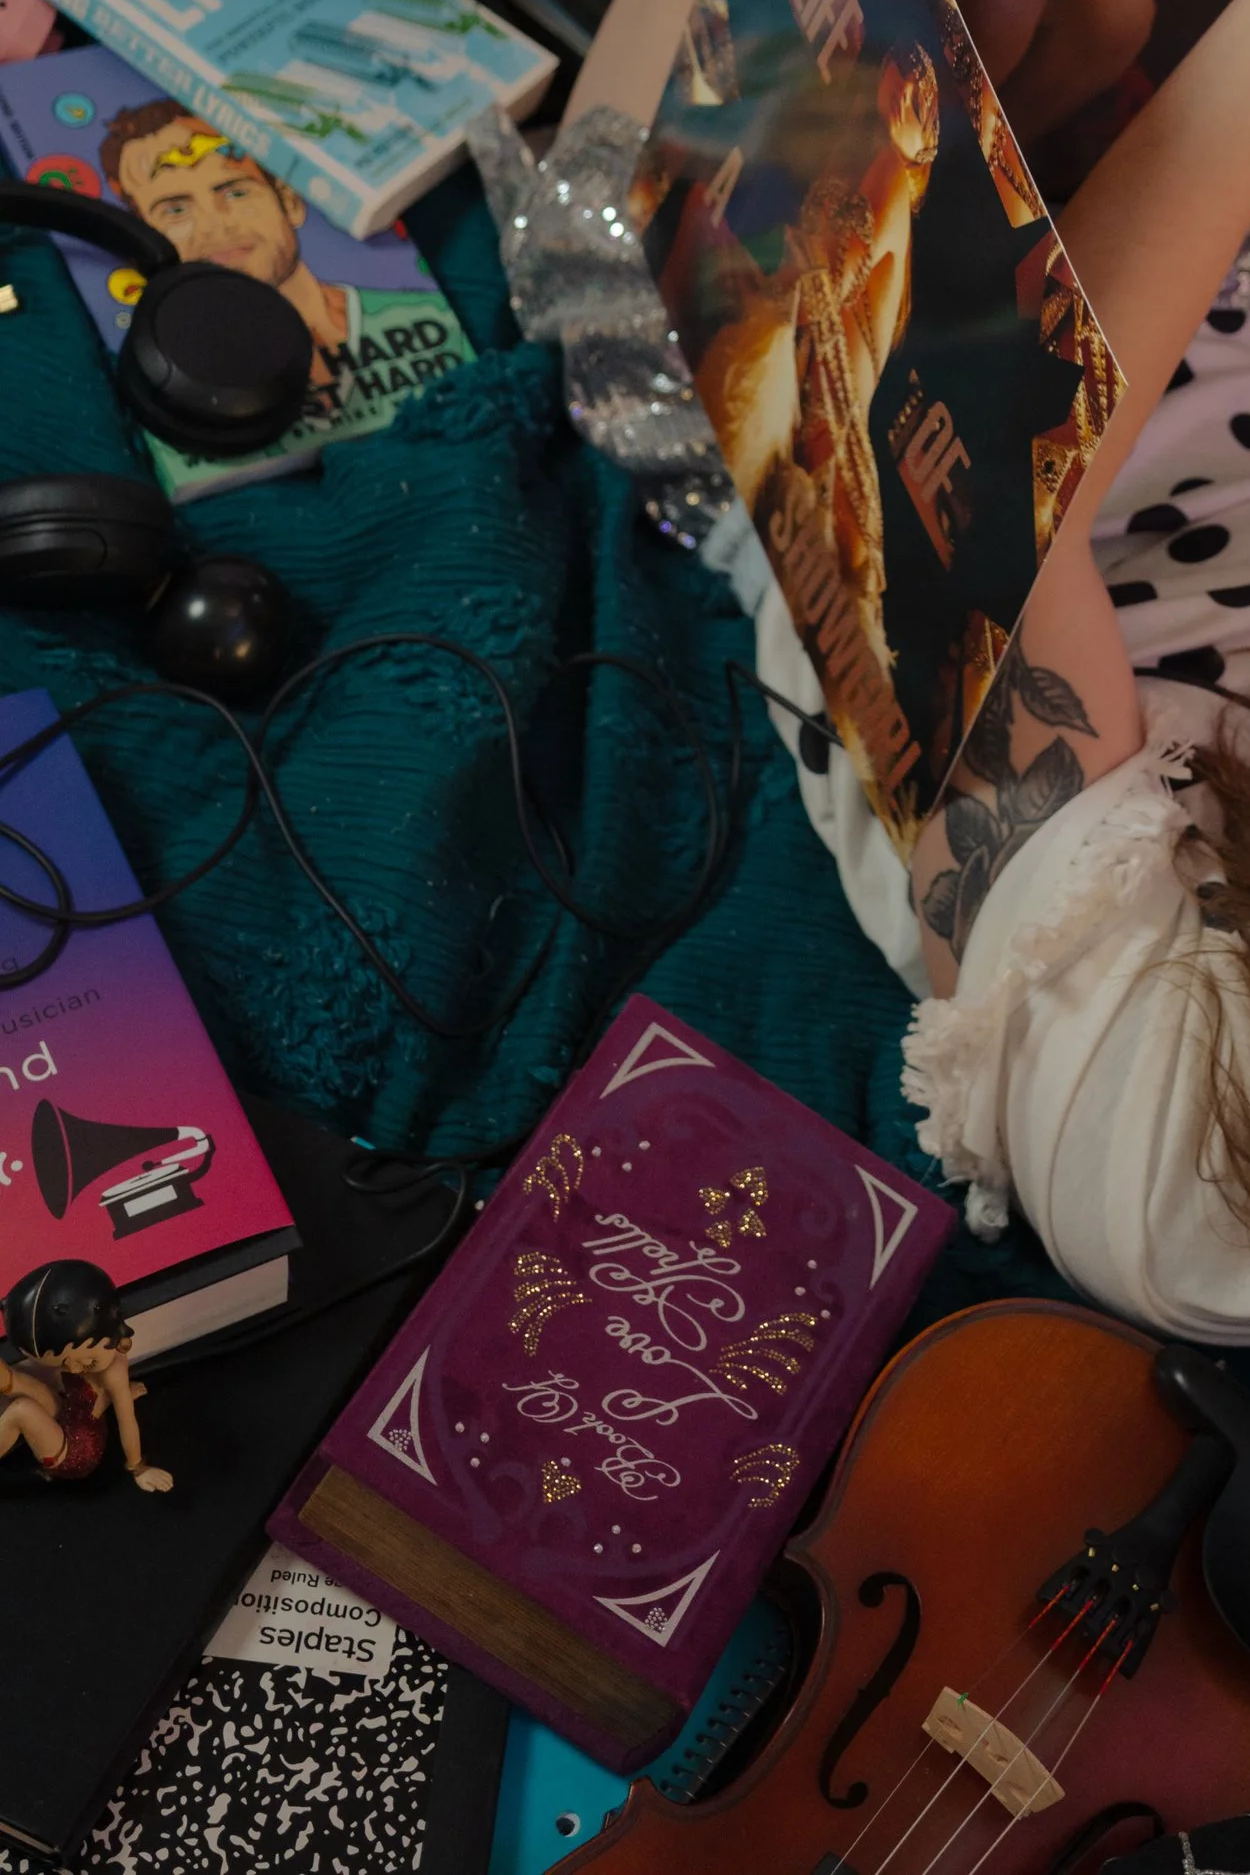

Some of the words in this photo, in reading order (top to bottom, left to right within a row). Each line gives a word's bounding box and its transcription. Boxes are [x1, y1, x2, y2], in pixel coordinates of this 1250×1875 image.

[192, 85, 273, 159] LYRICS
[319, 320, 449, 376] HARD
[903, 400, 972, 504] OF
[2, 987, 101, 1035] usician
[581, 1213, 746, 1352] Spells
[502, 1369, 580, 1423] Of
[601, 1315, 758, 1425] Love
[562, 1411, 681, 1501] Book
[270, 1569, 320, 1588] Ruled
[259, 1625, 377, 1663] Staples
